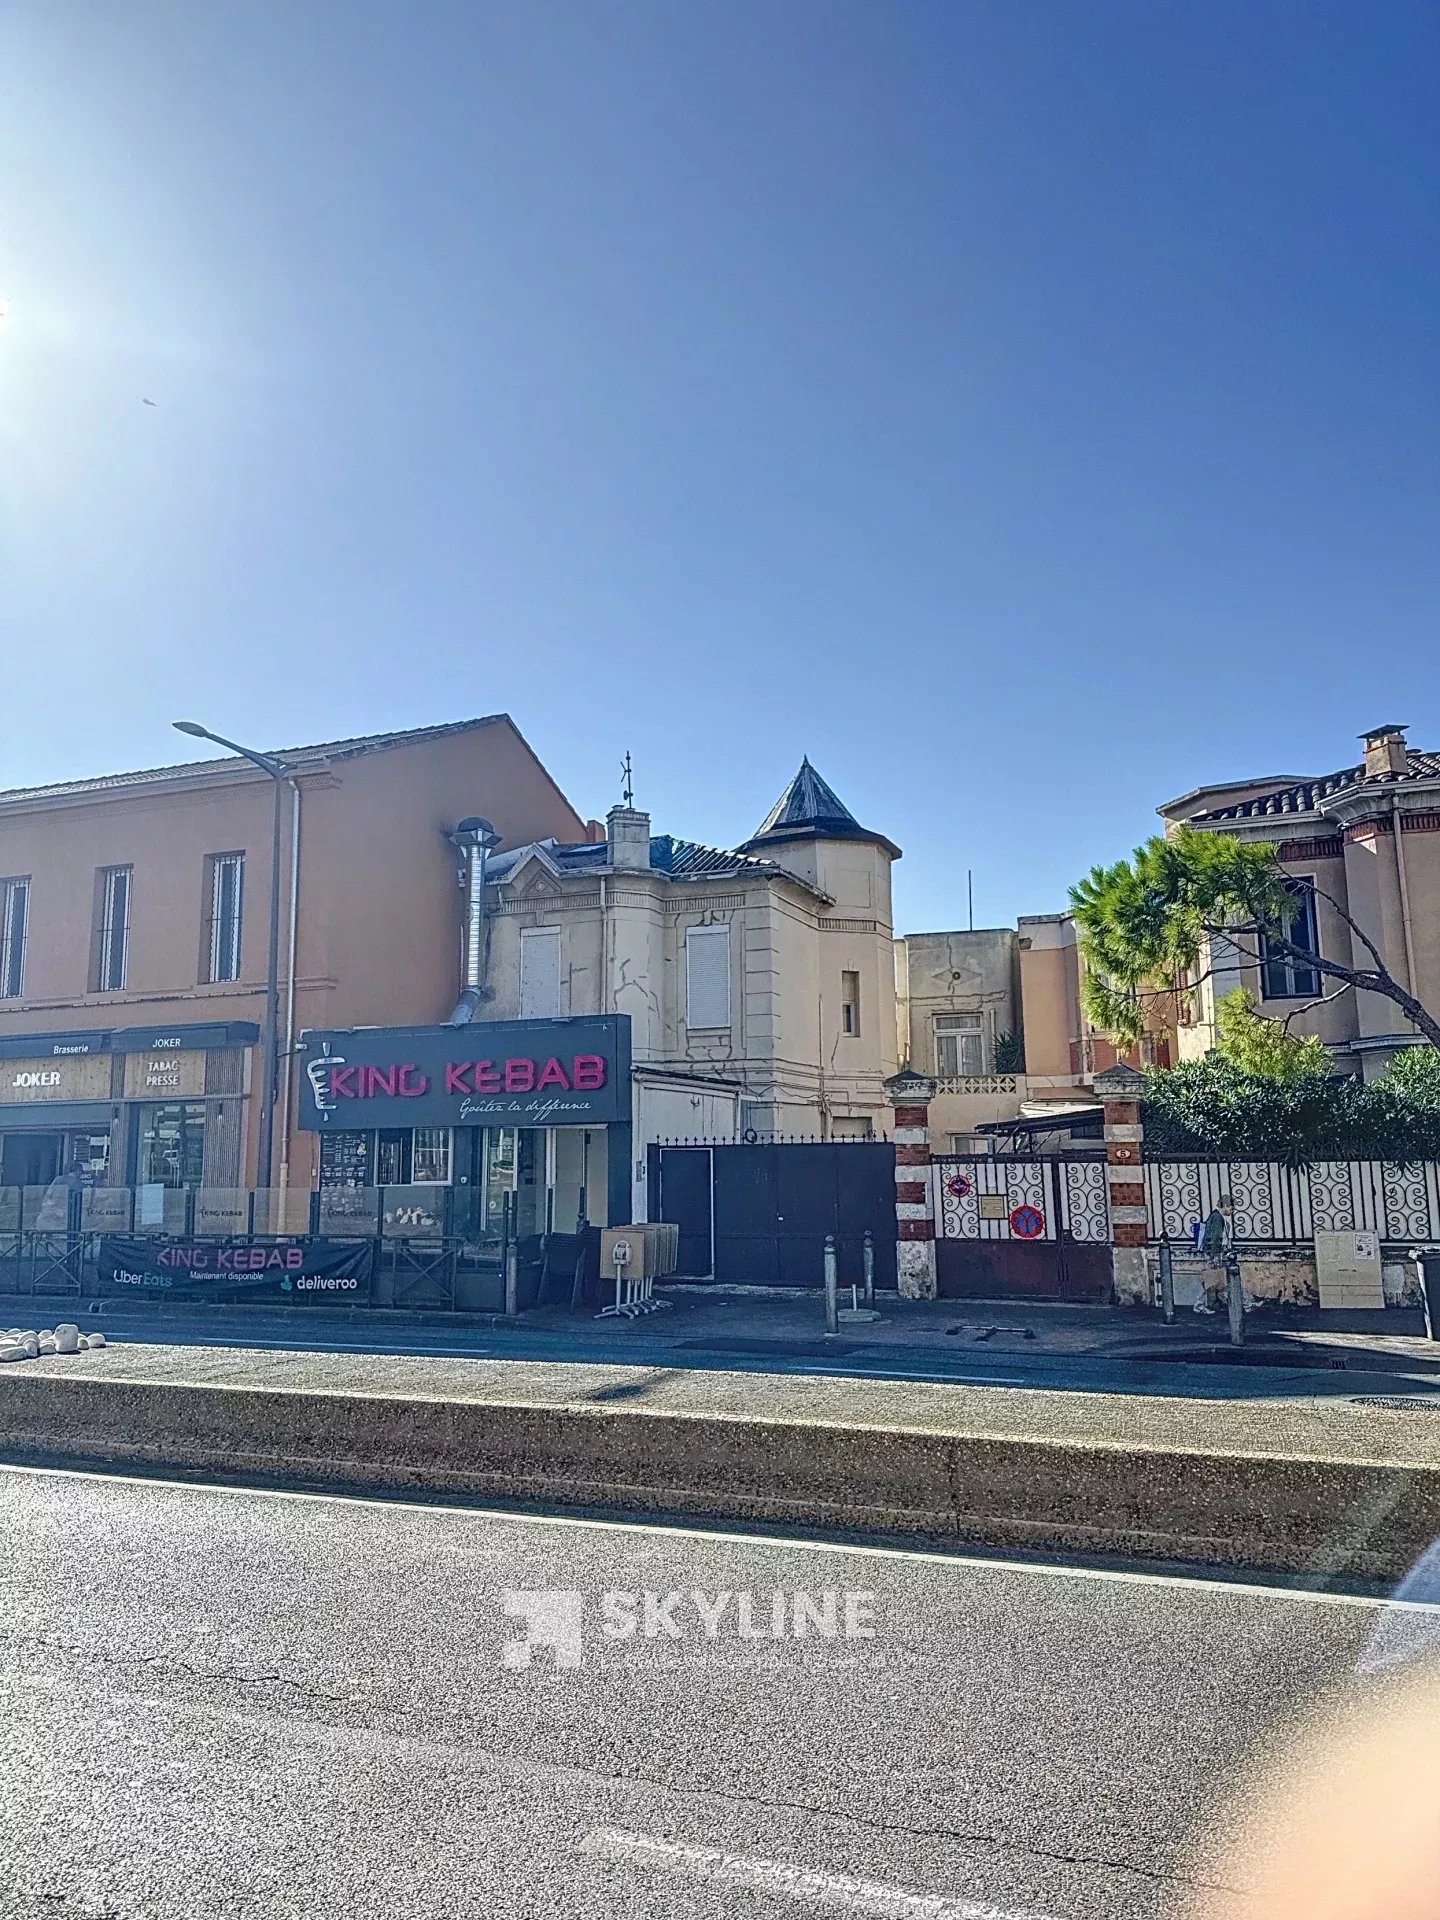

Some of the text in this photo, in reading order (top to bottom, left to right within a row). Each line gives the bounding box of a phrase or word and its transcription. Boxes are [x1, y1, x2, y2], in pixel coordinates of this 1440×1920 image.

[152, 1038, 181, 1048] JOKER
[53, 1044, 89, 1054] Brasserie
[148, 1061, 179, 1072] TABAC
[12, 1071, 61, 1087] JOKER
[146, 1075, 179, 1086] PRESSE
[330, 1055, 606, 1098] KING KEBAB
[460, 1098, 591, 1121] Goûtez la différence
[1120, 1150, 1127, 1158] 5
[217, 1249, 303, 1269] KEBAB
[190, 1270, 264, 1281] Maintenant disponible
[297, 1276, 358, 1290] deliveroo
